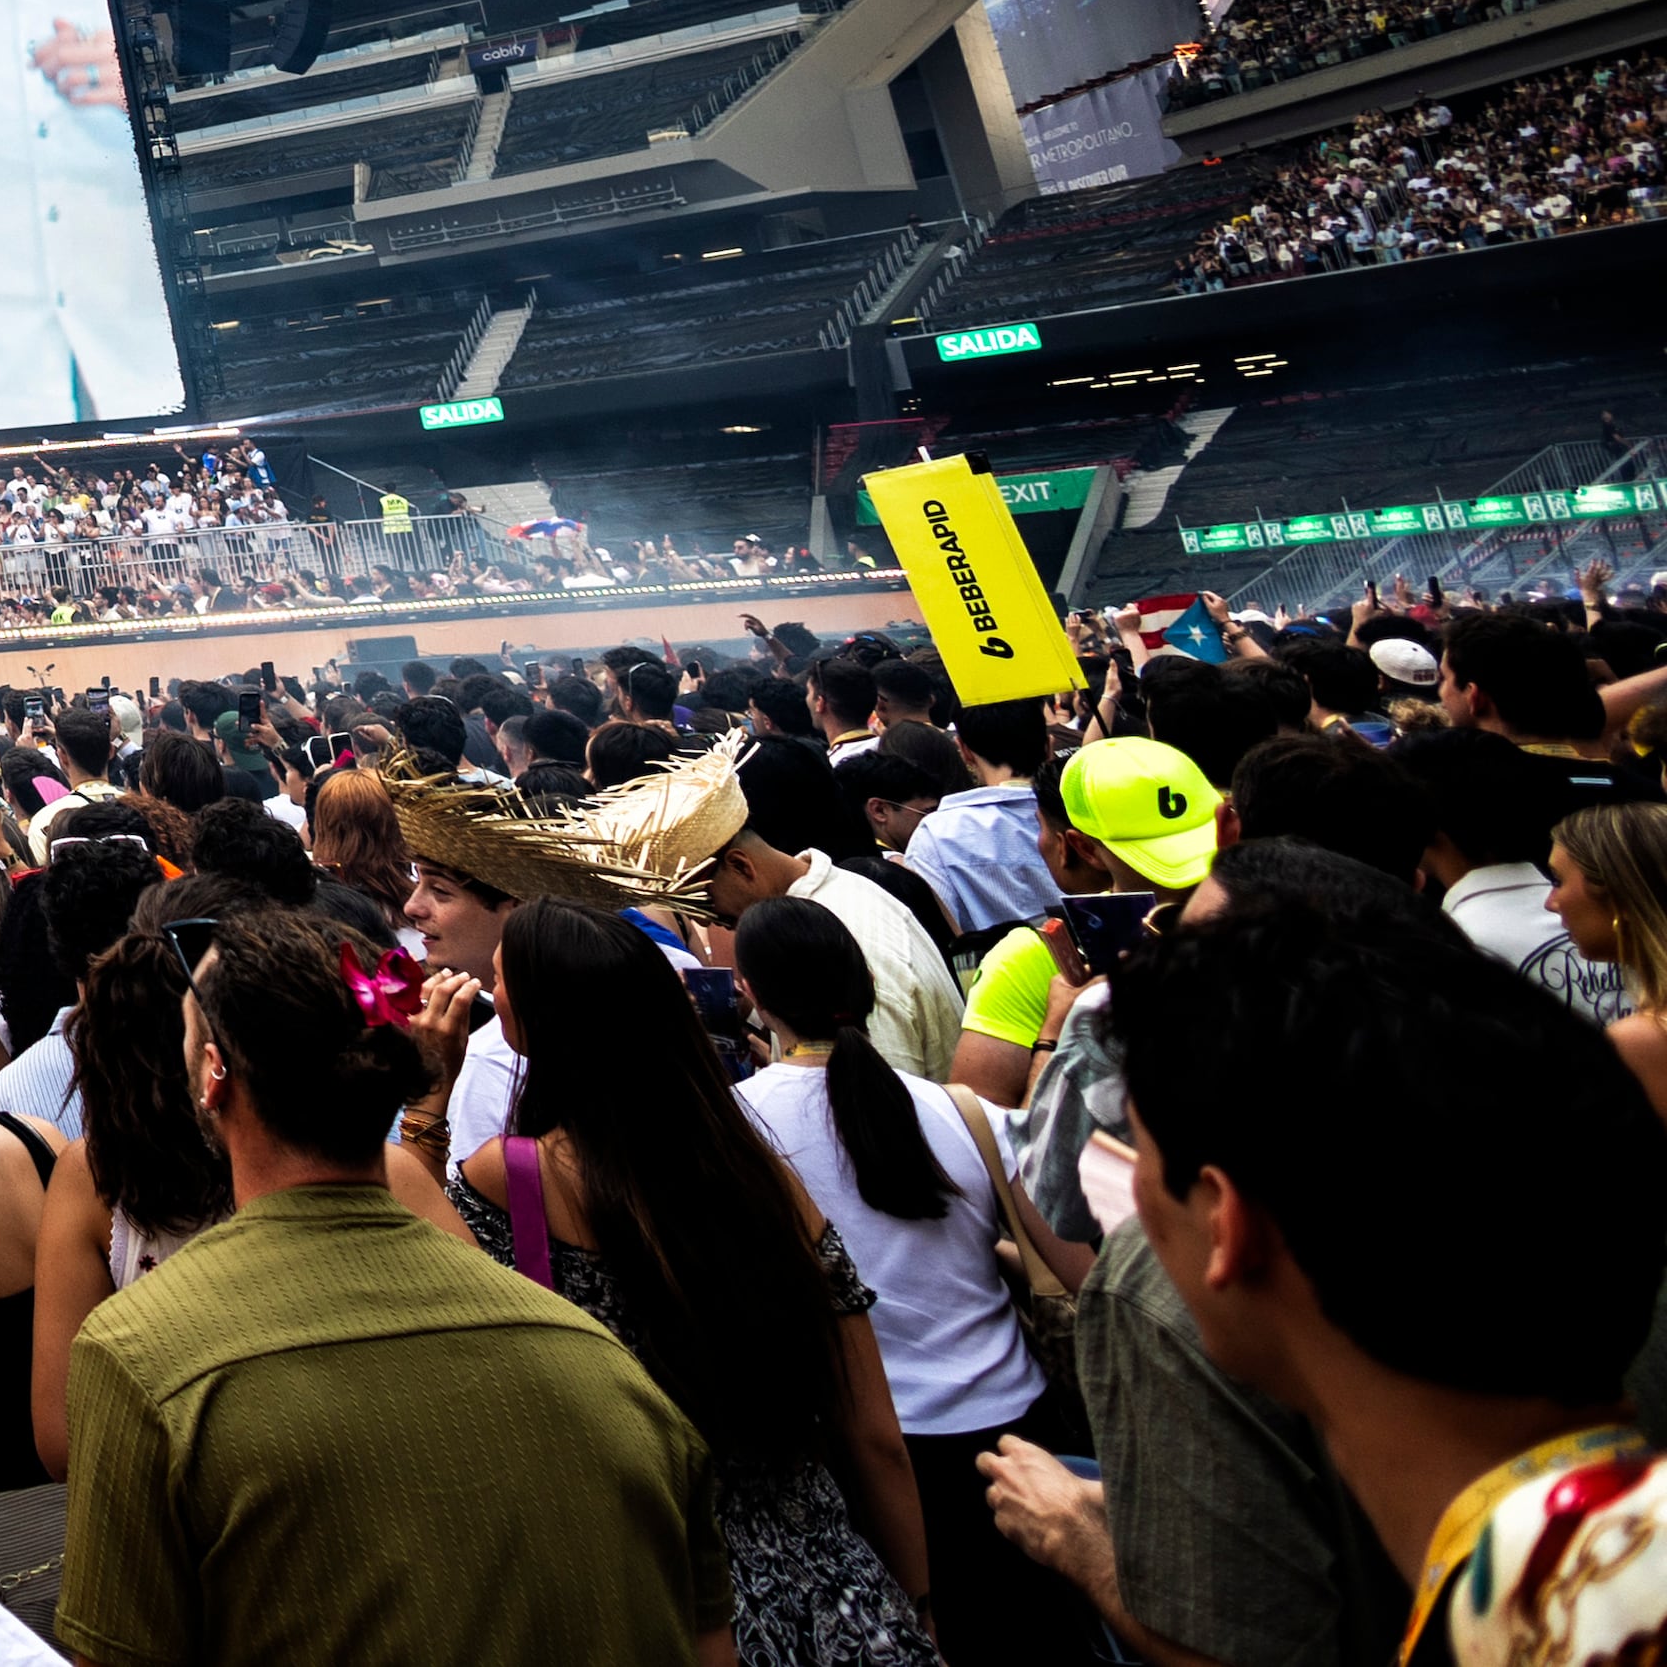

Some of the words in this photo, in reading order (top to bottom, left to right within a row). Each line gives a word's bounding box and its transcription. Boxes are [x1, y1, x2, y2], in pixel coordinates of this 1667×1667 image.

[482, 43, 527, 62] cabify
[941, 326, 1038, 357] SALIDA
[424, 399, 501, 426] SALIDA
[923, 499, 999, 633] BEBERAPID
